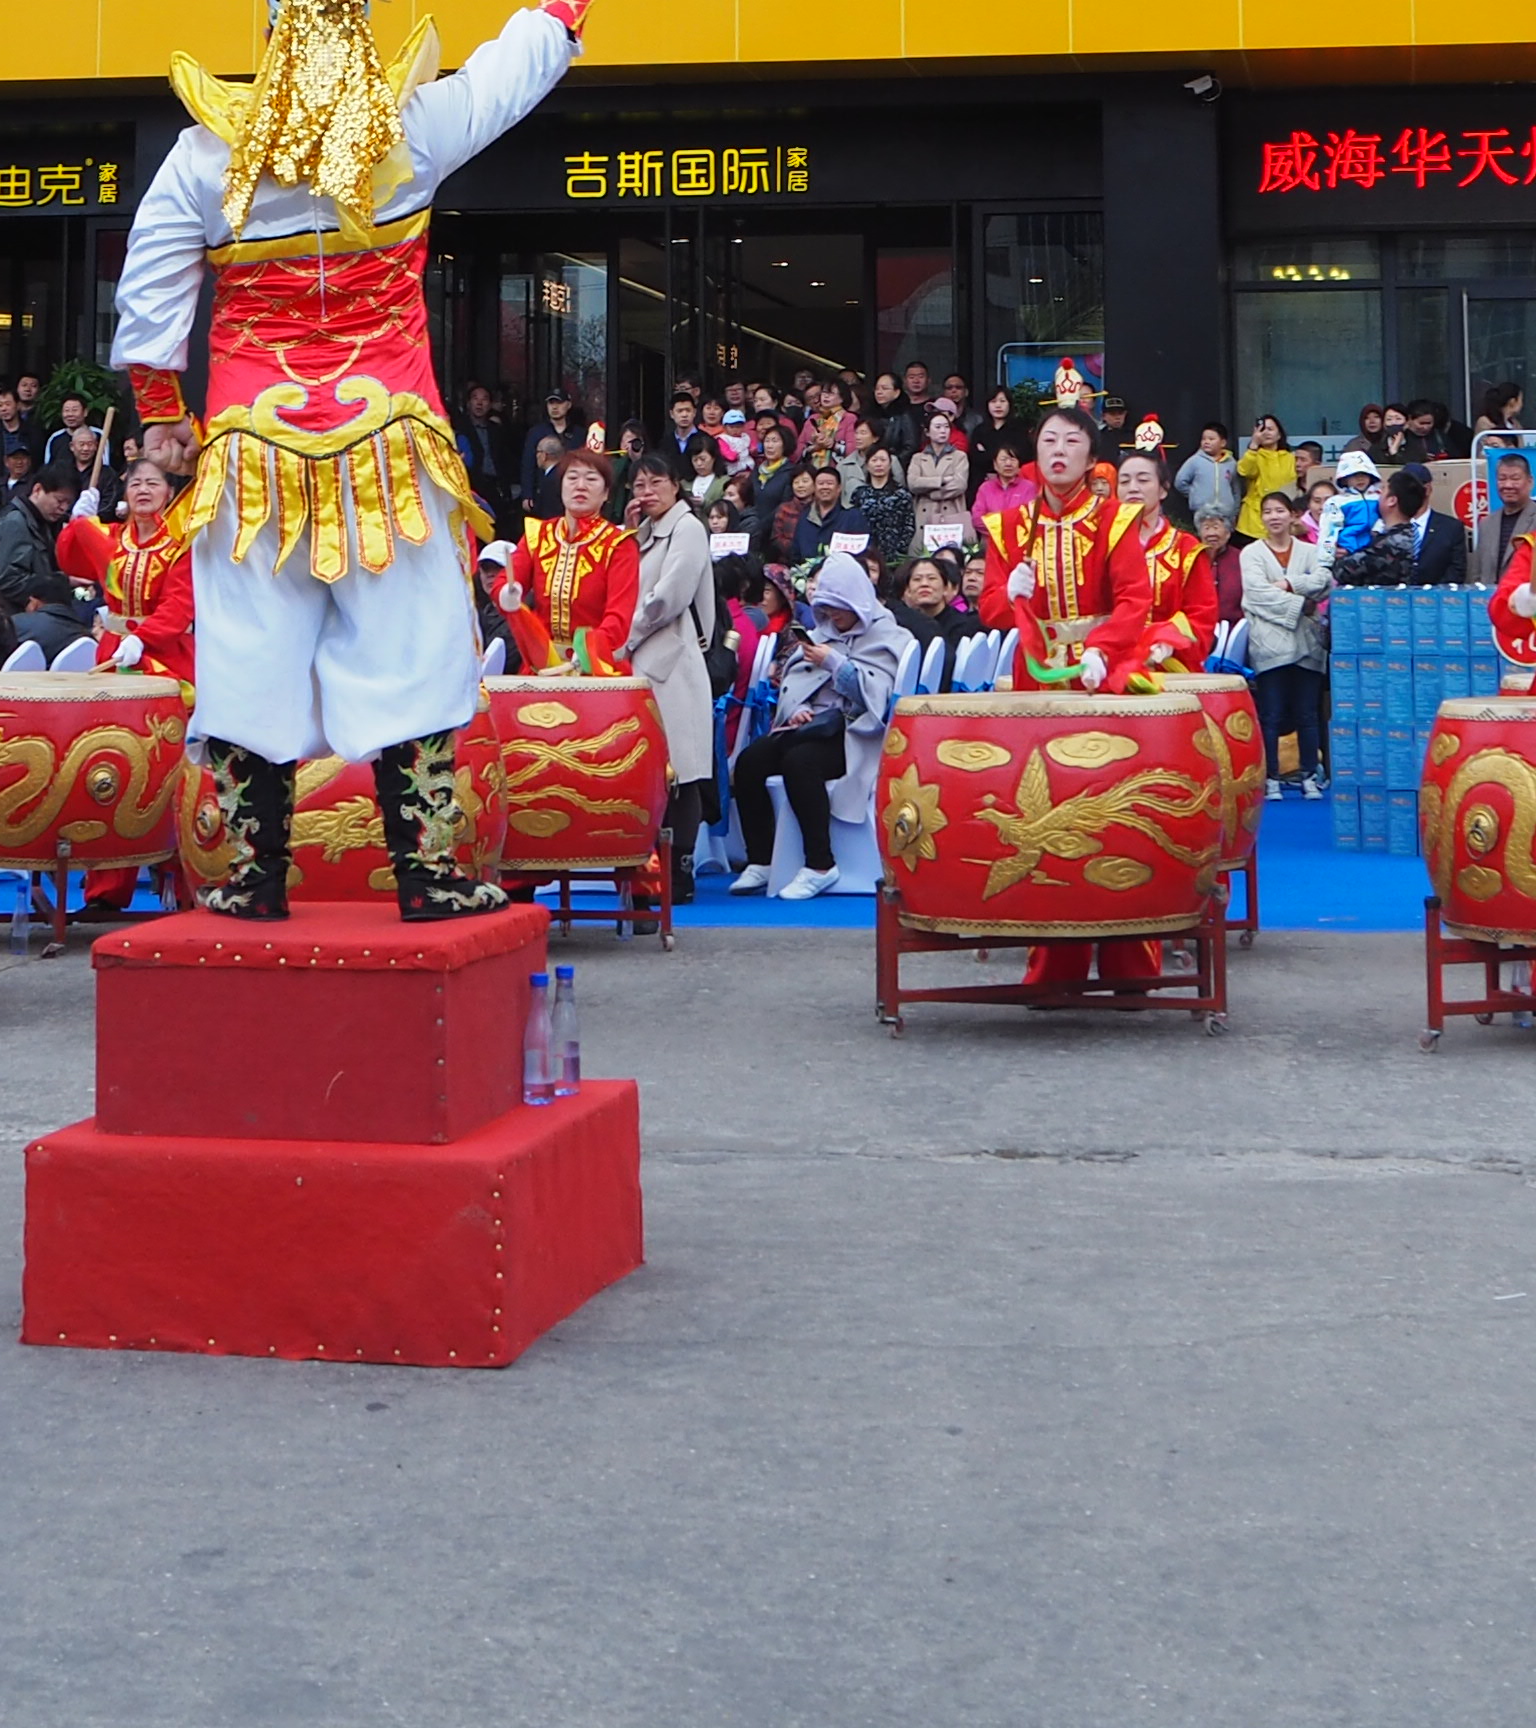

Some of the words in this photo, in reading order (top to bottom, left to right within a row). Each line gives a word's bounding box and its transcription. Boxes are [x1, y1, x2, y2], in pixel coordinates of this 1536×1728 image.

[98, 162, 119, 204] 家居
[564, 148, 770, 198] 吉斯国际
[786, 147, 809, 194] 家居
